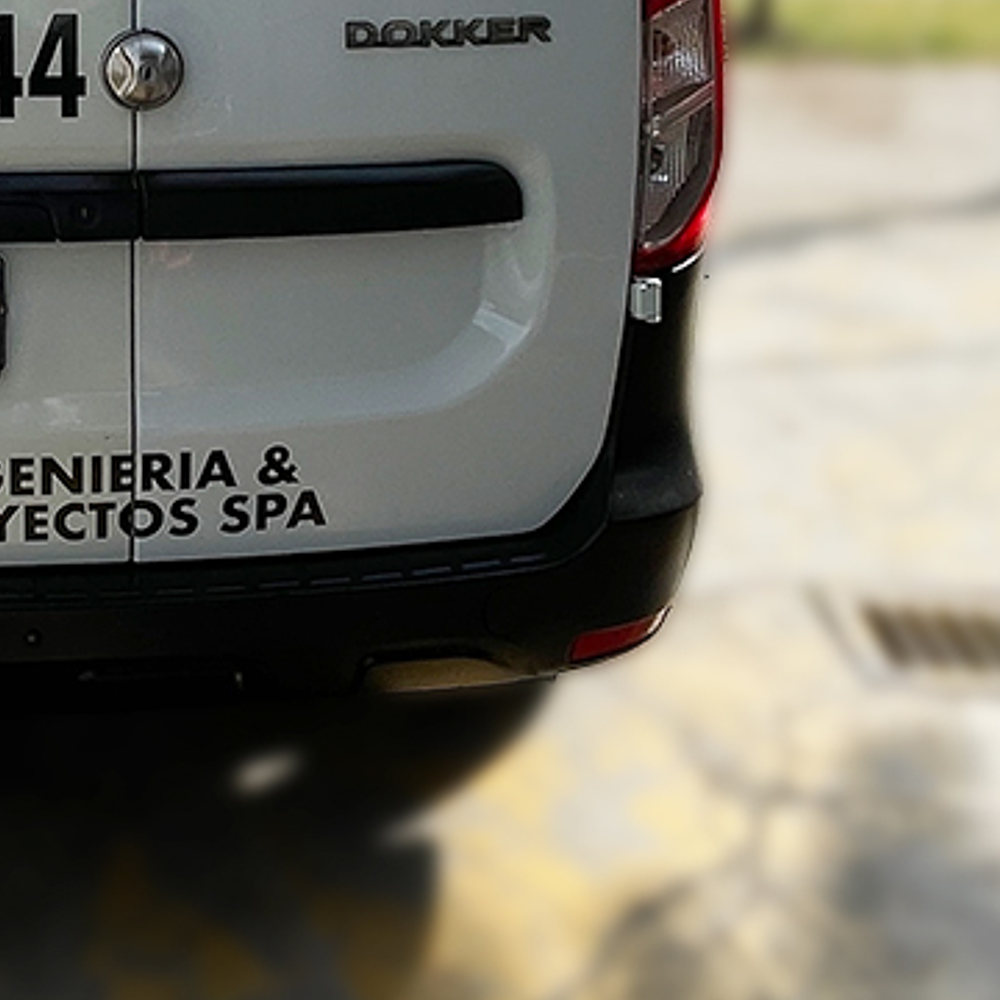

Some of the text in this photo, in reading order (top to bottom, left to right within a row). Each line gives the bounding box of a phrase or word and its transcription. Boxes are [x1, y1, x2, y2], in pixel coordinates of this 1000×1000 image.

[345, 14, 552, 49] DOKKER
[257, 445, 299, 486] &
[219, 490, 326, 533] SPA
